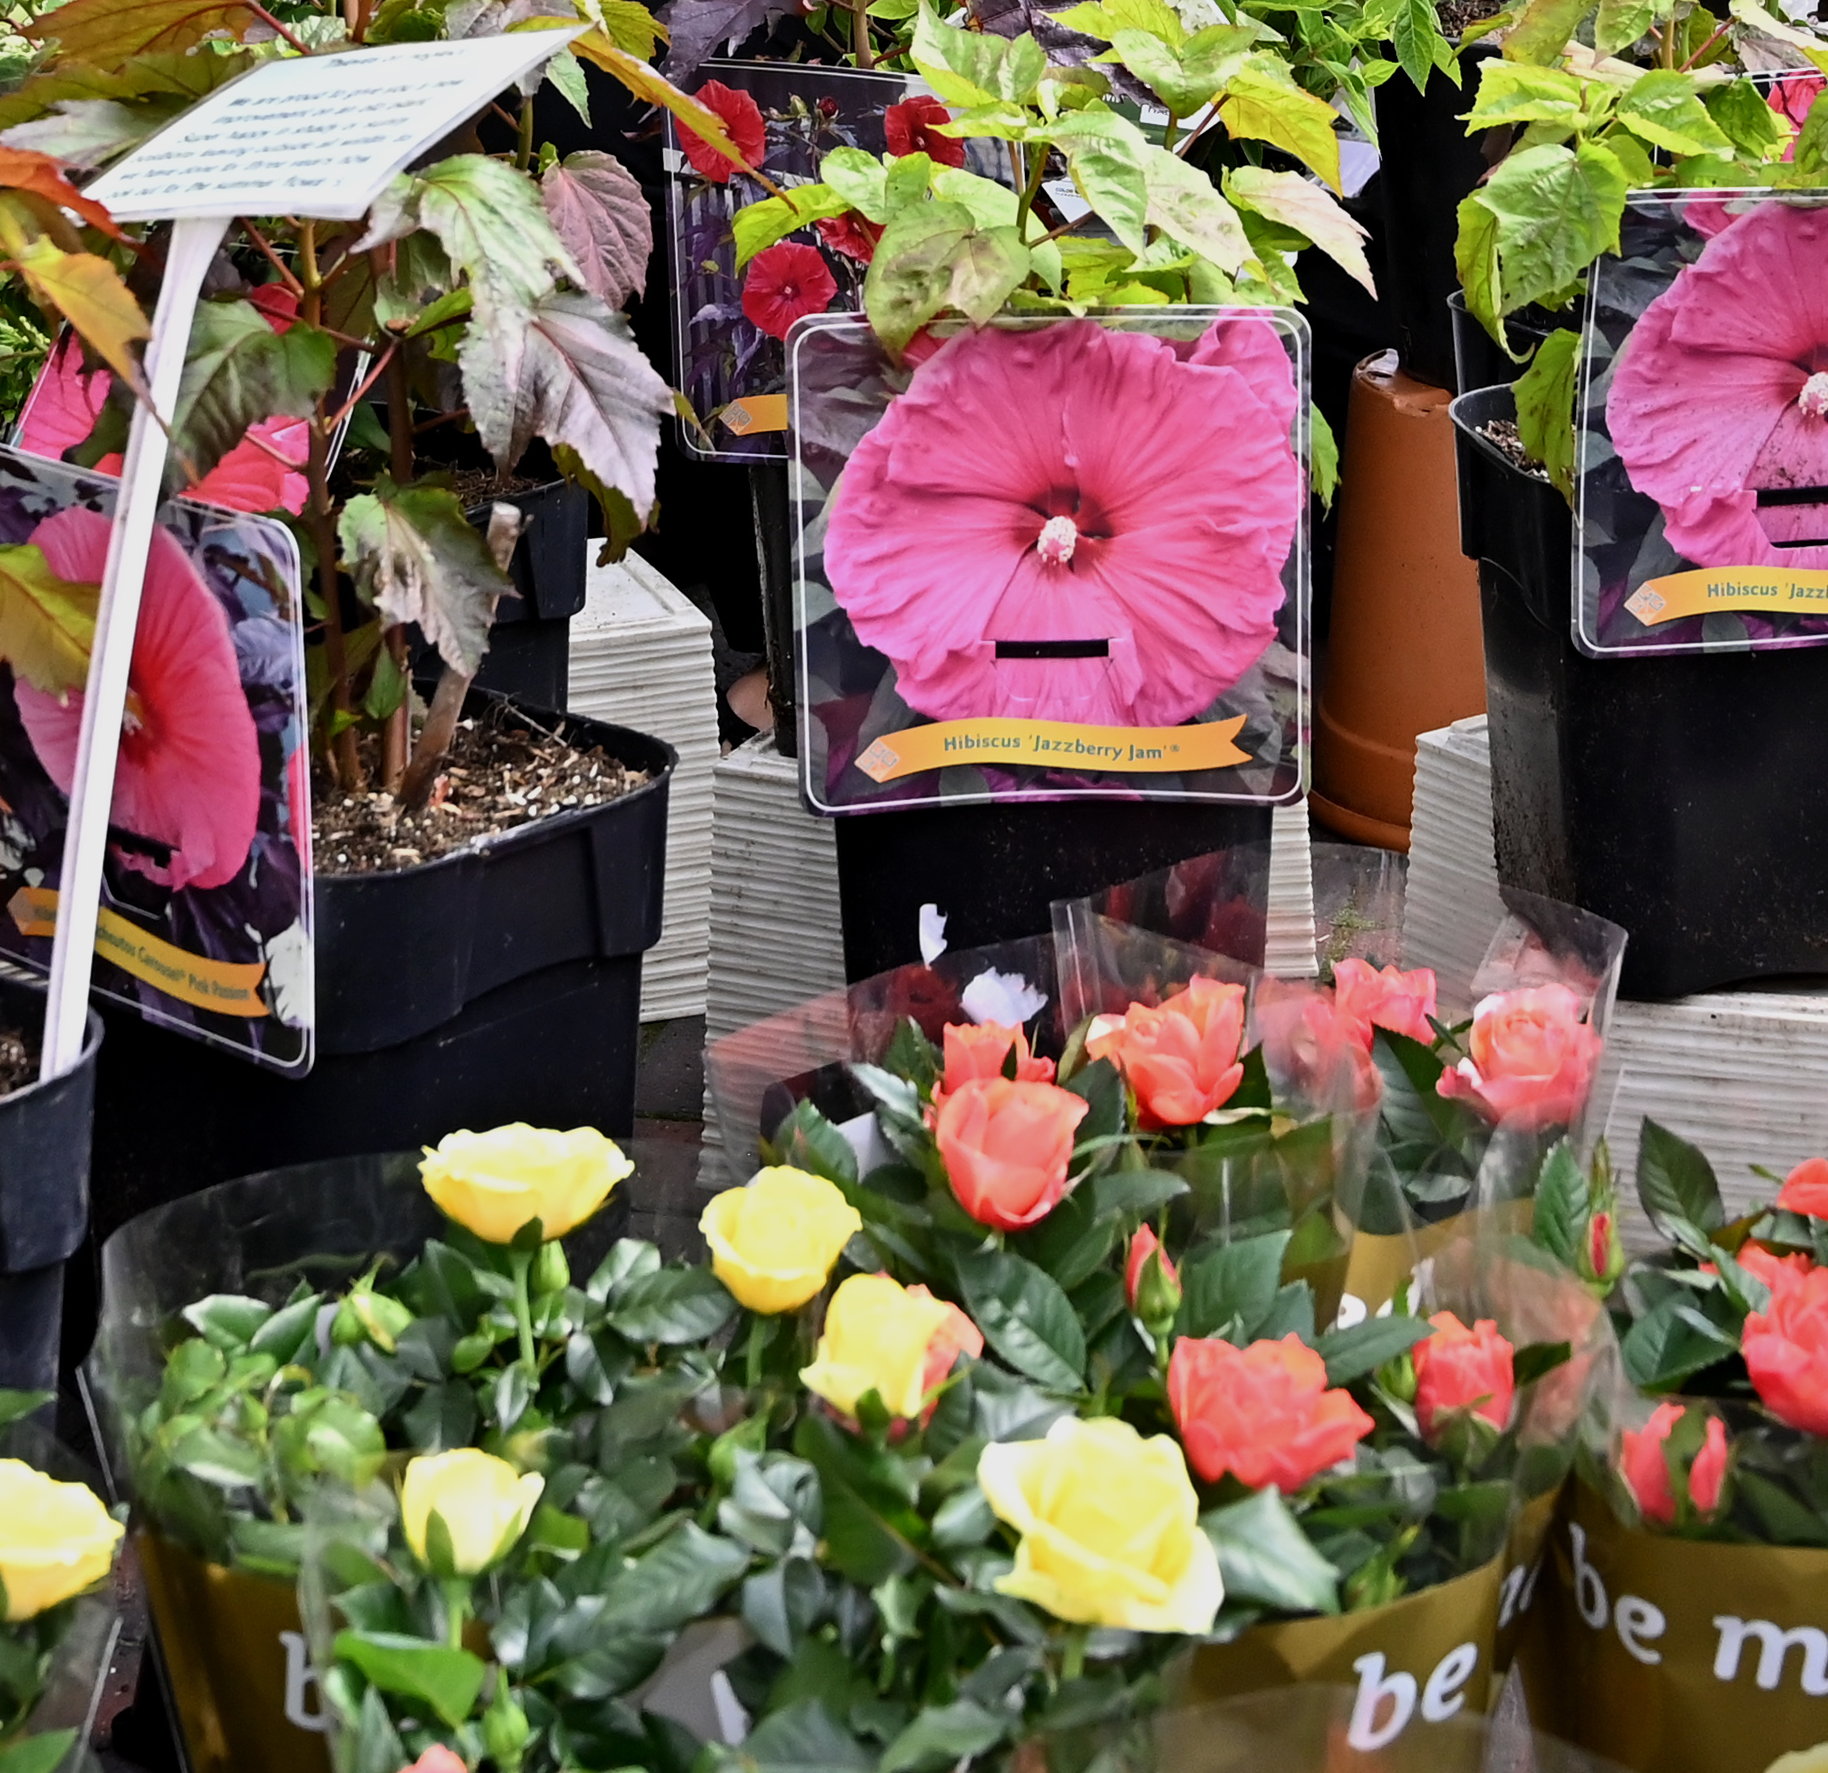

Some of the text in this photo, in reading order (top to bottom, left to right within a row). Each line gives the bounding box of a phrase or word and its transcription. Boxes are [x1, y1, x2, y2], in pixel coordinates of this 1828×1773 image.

[1707, 582, 1779, 599] Hibiscus
[943, 734, 1022, 752] Hibiscus
[1568, 1520, 1666, 1666] be
[1346, 1641, 1478, 1753] be
